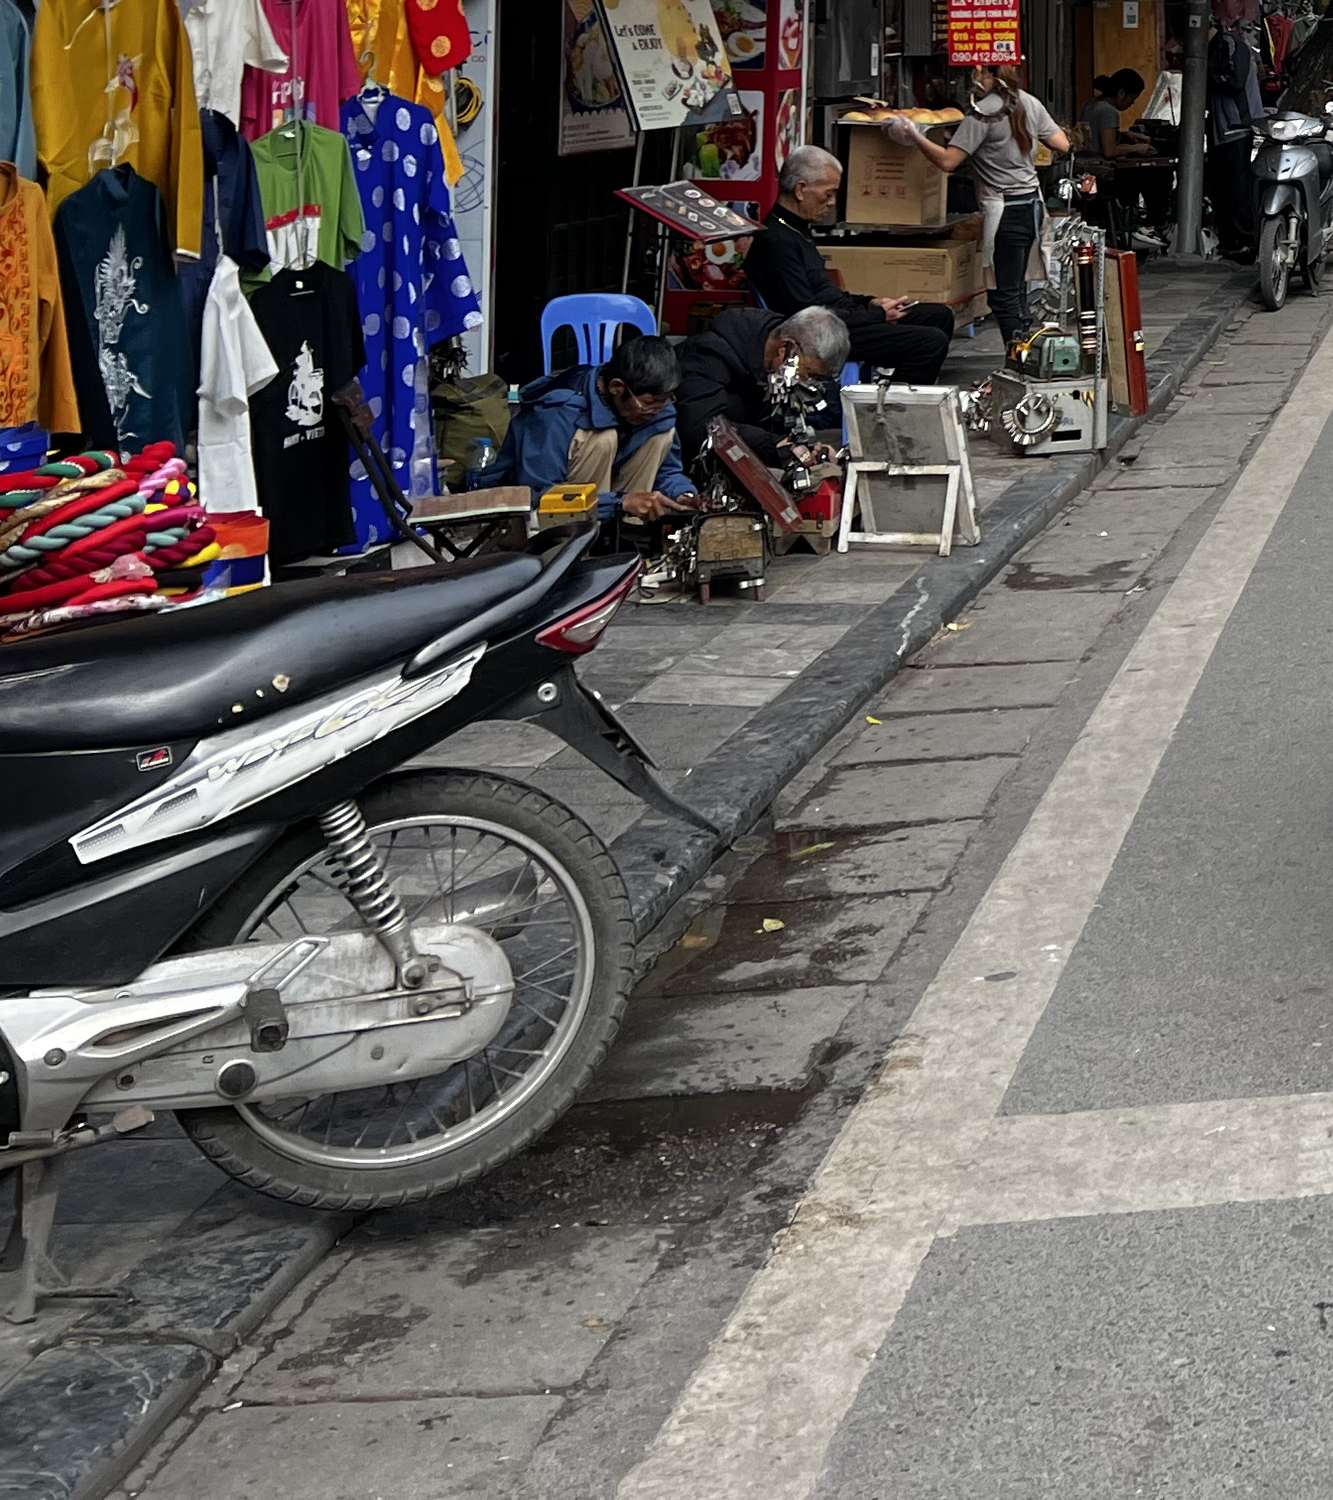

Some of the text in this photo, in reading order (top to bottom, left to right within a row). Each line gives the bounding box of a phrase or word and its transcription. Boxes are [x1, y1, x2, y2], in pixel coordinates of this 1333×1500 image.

[614, 23, 656, 37] Let's COME
[639, 38, 663, 51] ENJOY
